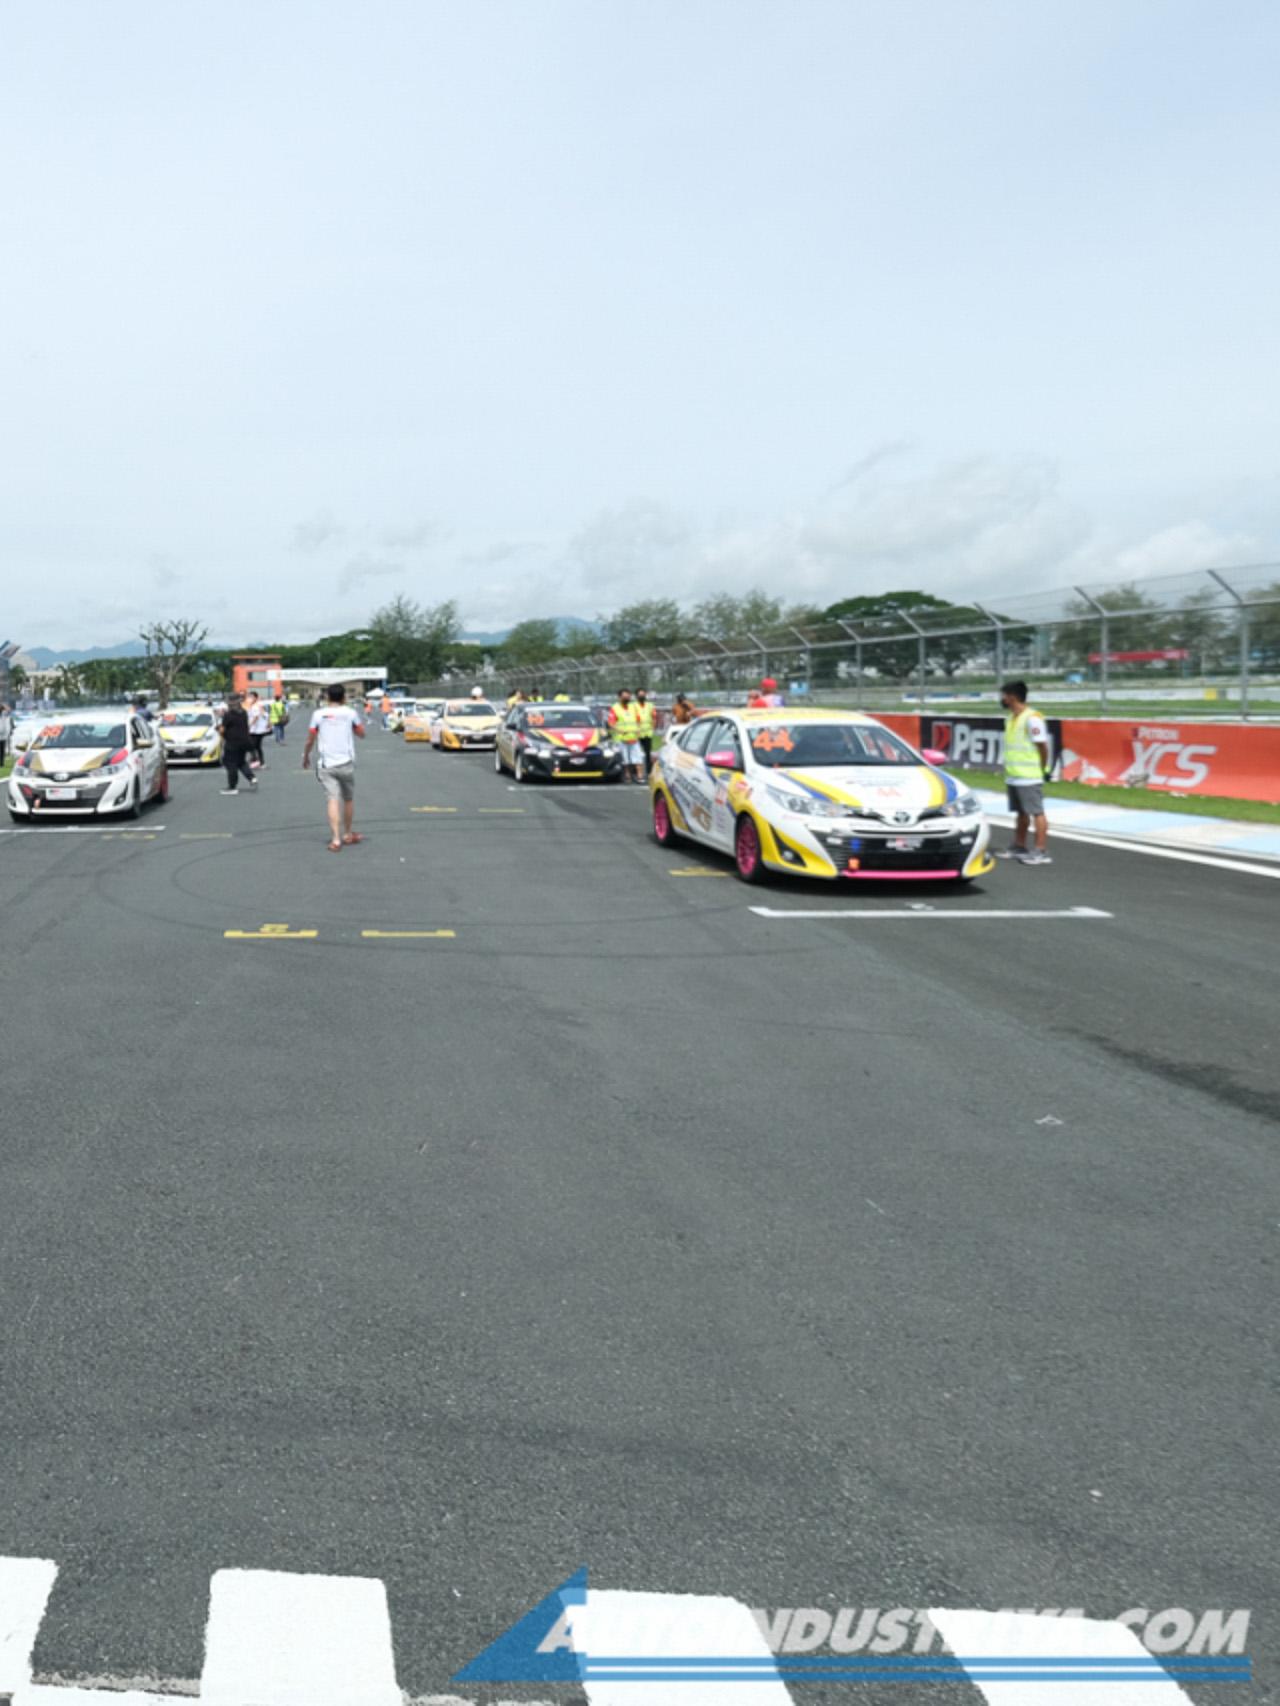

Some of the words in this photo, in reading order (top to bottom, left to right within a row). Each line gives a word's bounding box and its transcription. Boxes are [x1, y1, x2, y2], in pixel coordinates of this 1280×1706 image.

[753, 729, 795, 752] 44
[1138, 727, 1179, 741] PETRON
[1120, 741, 1216, 788] XCS
